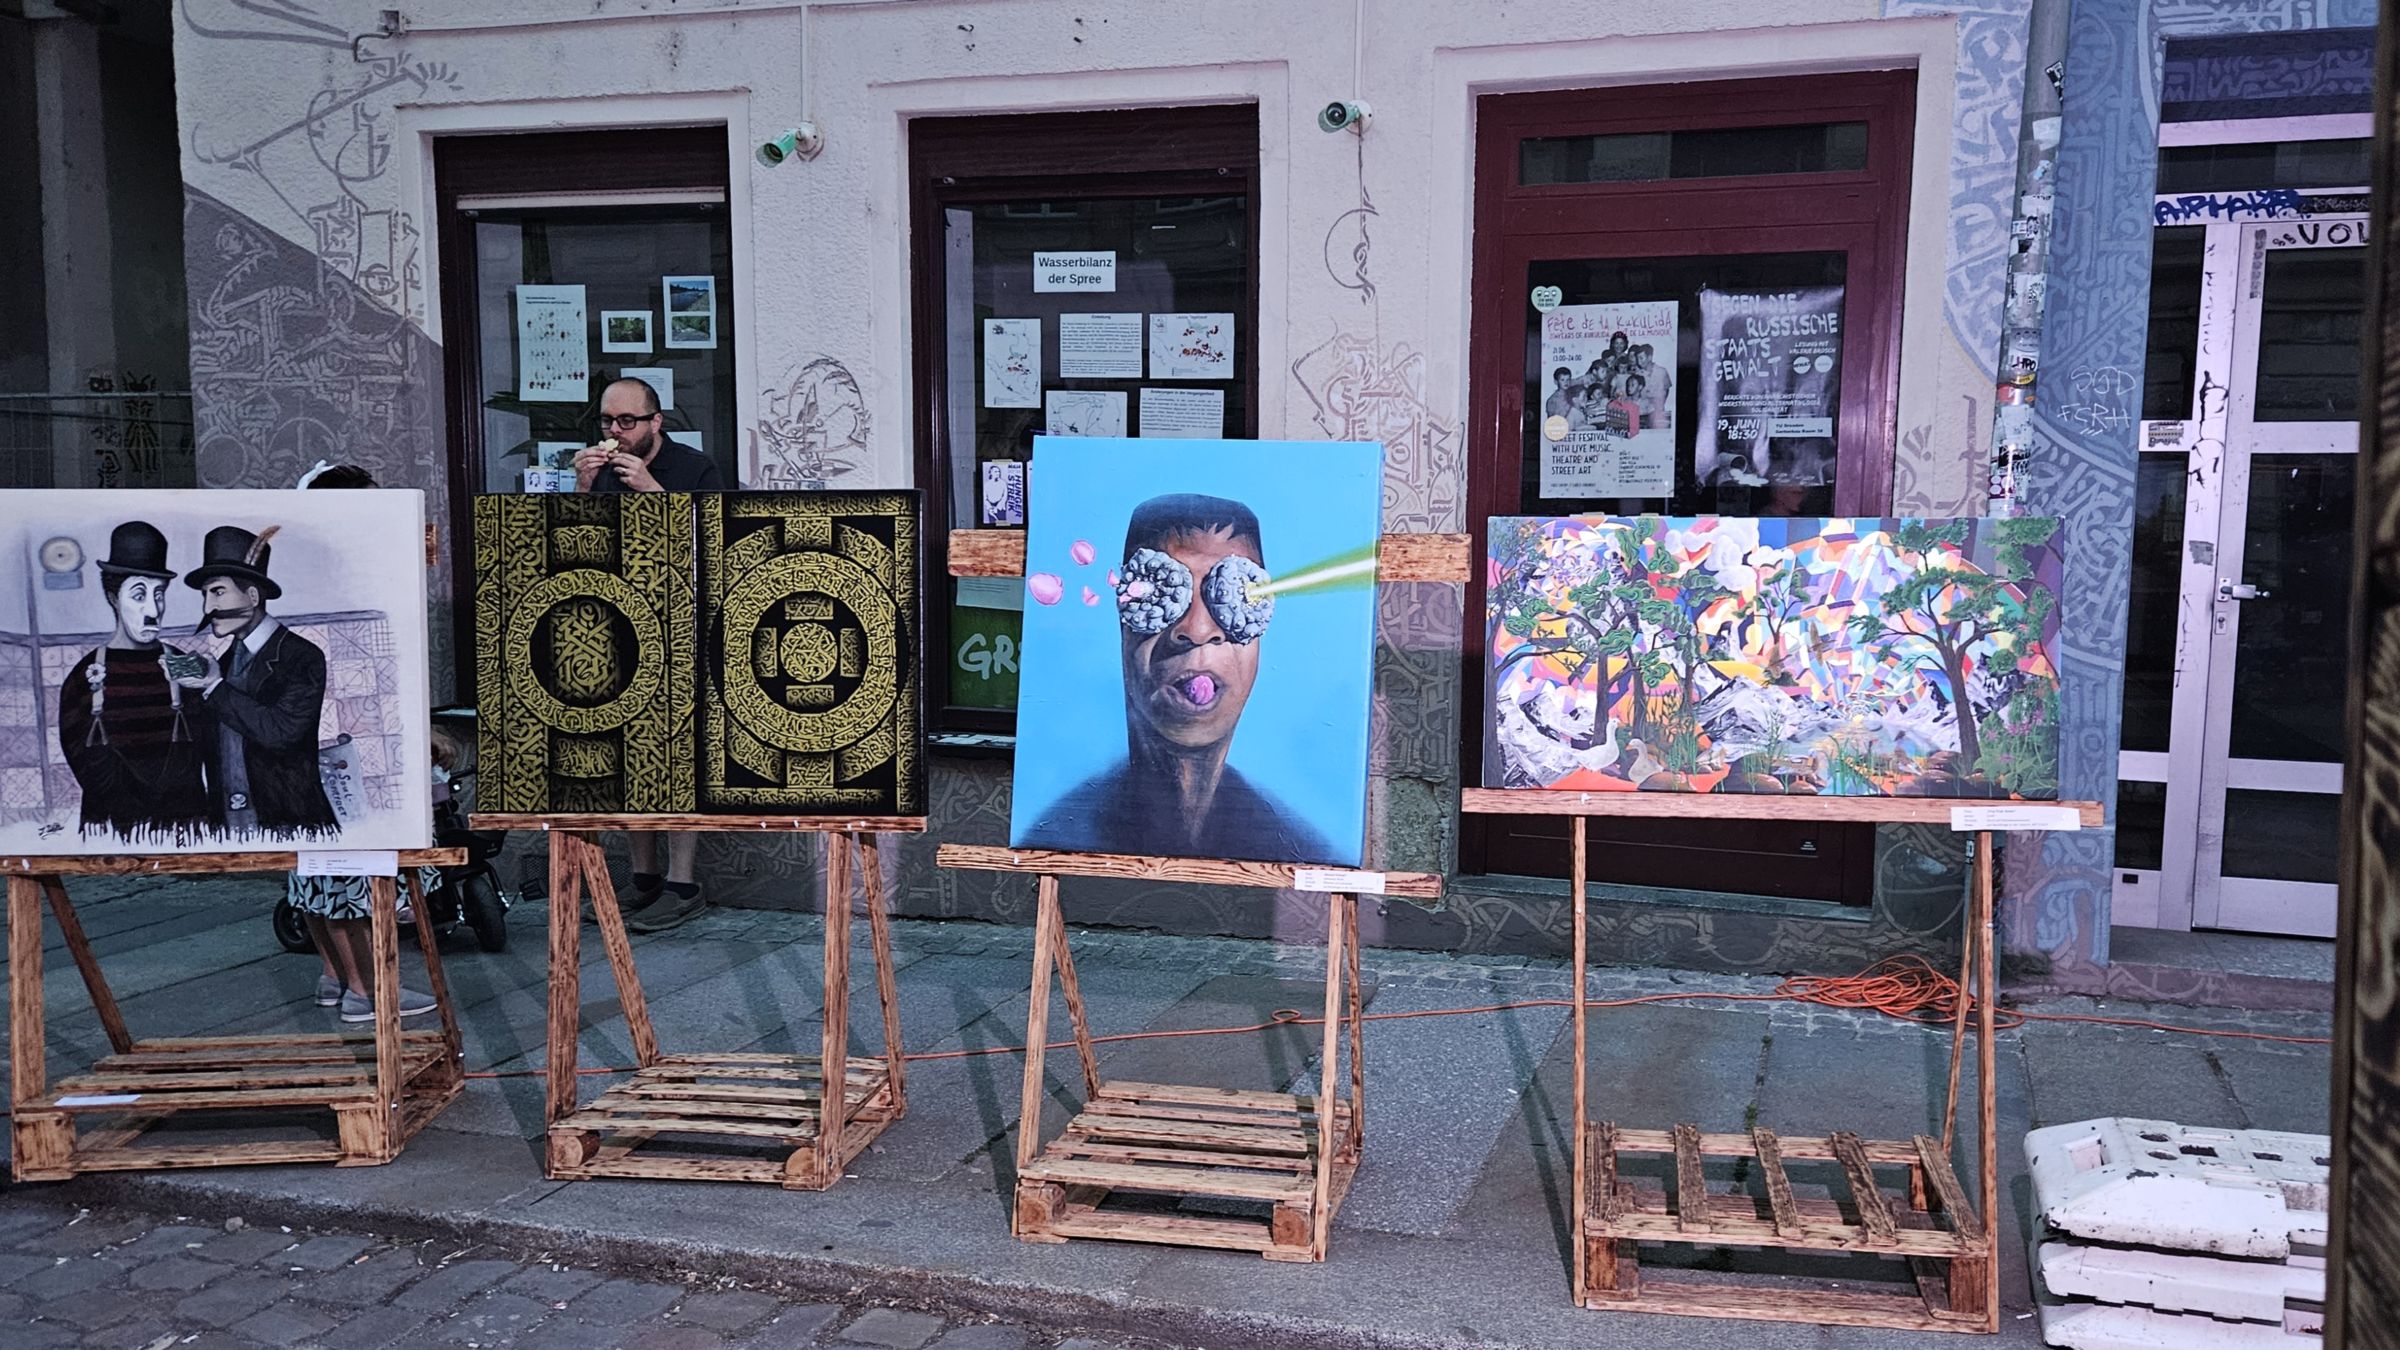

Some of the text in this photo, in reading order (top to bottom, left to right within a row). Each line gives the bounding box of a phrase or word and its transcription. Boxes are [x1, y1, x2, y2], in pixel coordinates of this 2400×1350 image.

[1038, 256, 1113, 268] Wasserbilanz
[1048, 273, 1102, 287] der Spree
[1712, 293, 1797, 315] GEGEN DIE
[1746, 313, 1838, 337] RUSSISCHE
[1705, 337, 1771, 359] STAATS
[1714, 356, 1781, 381] GEWALT
[1578, 432, 1609, 442] FESTIVAL
[1728, 429, 1758, 440] 18:30
[1551, 444, 1570, 453] WITH
[1571, 444, 1587, 453] LIVE
[1552, 455, 1599, 464] THEATRE AND
[1551, 465, 1592, 475] STREET ART
[1014, 474, 1022, 518] HUNGER
[957, 633, 1023, 680] GR
